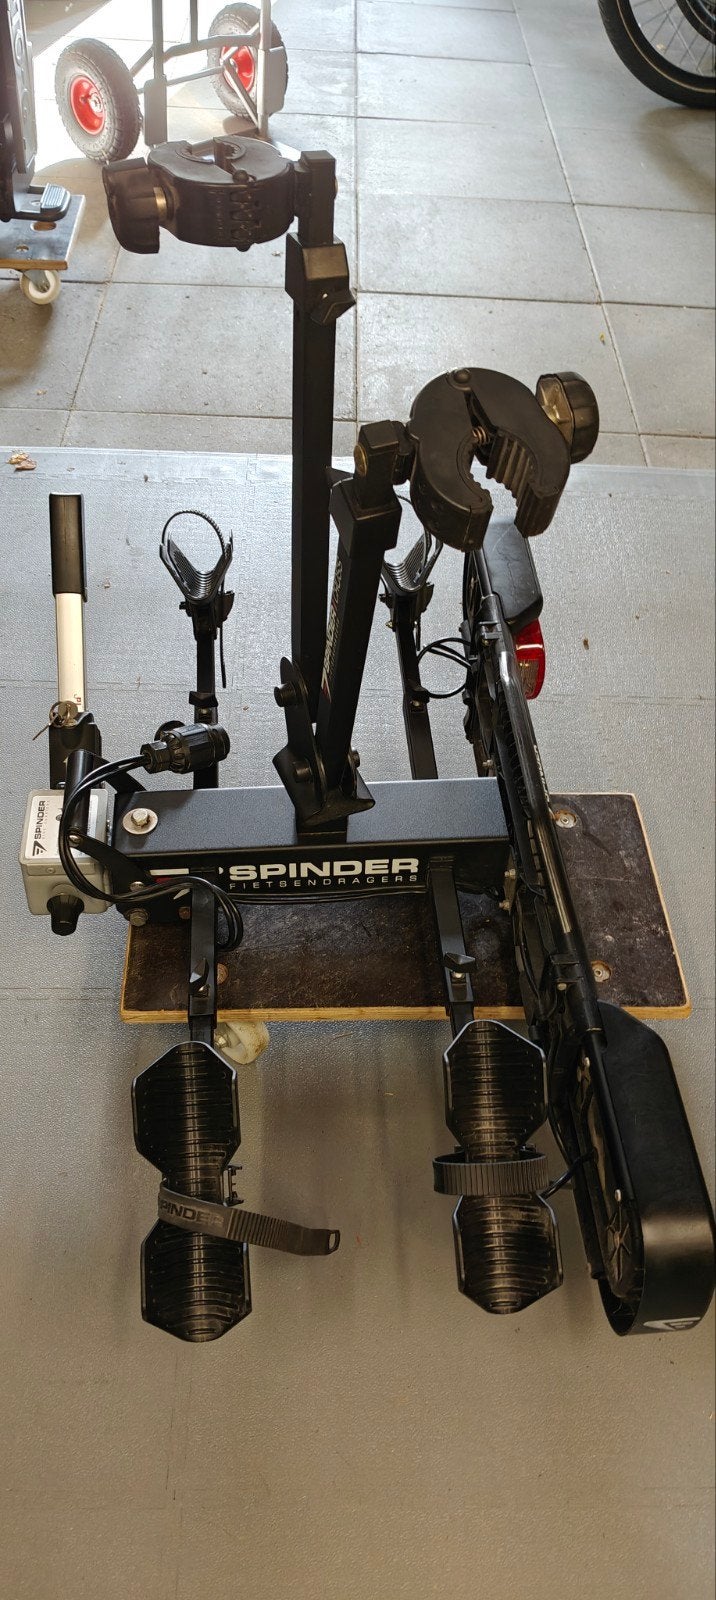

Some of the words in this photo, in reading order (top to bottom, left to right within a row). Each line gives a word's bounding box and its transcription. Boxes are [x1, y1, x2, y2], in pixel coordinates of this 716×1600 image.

[34, 800, 46, 839] SPINDER
[229, 857, 419, 880] SPINDER
[229, 874, 418, 890] FIETSENDRAGERS
[159, 1200, 225, 1224] PINDER
